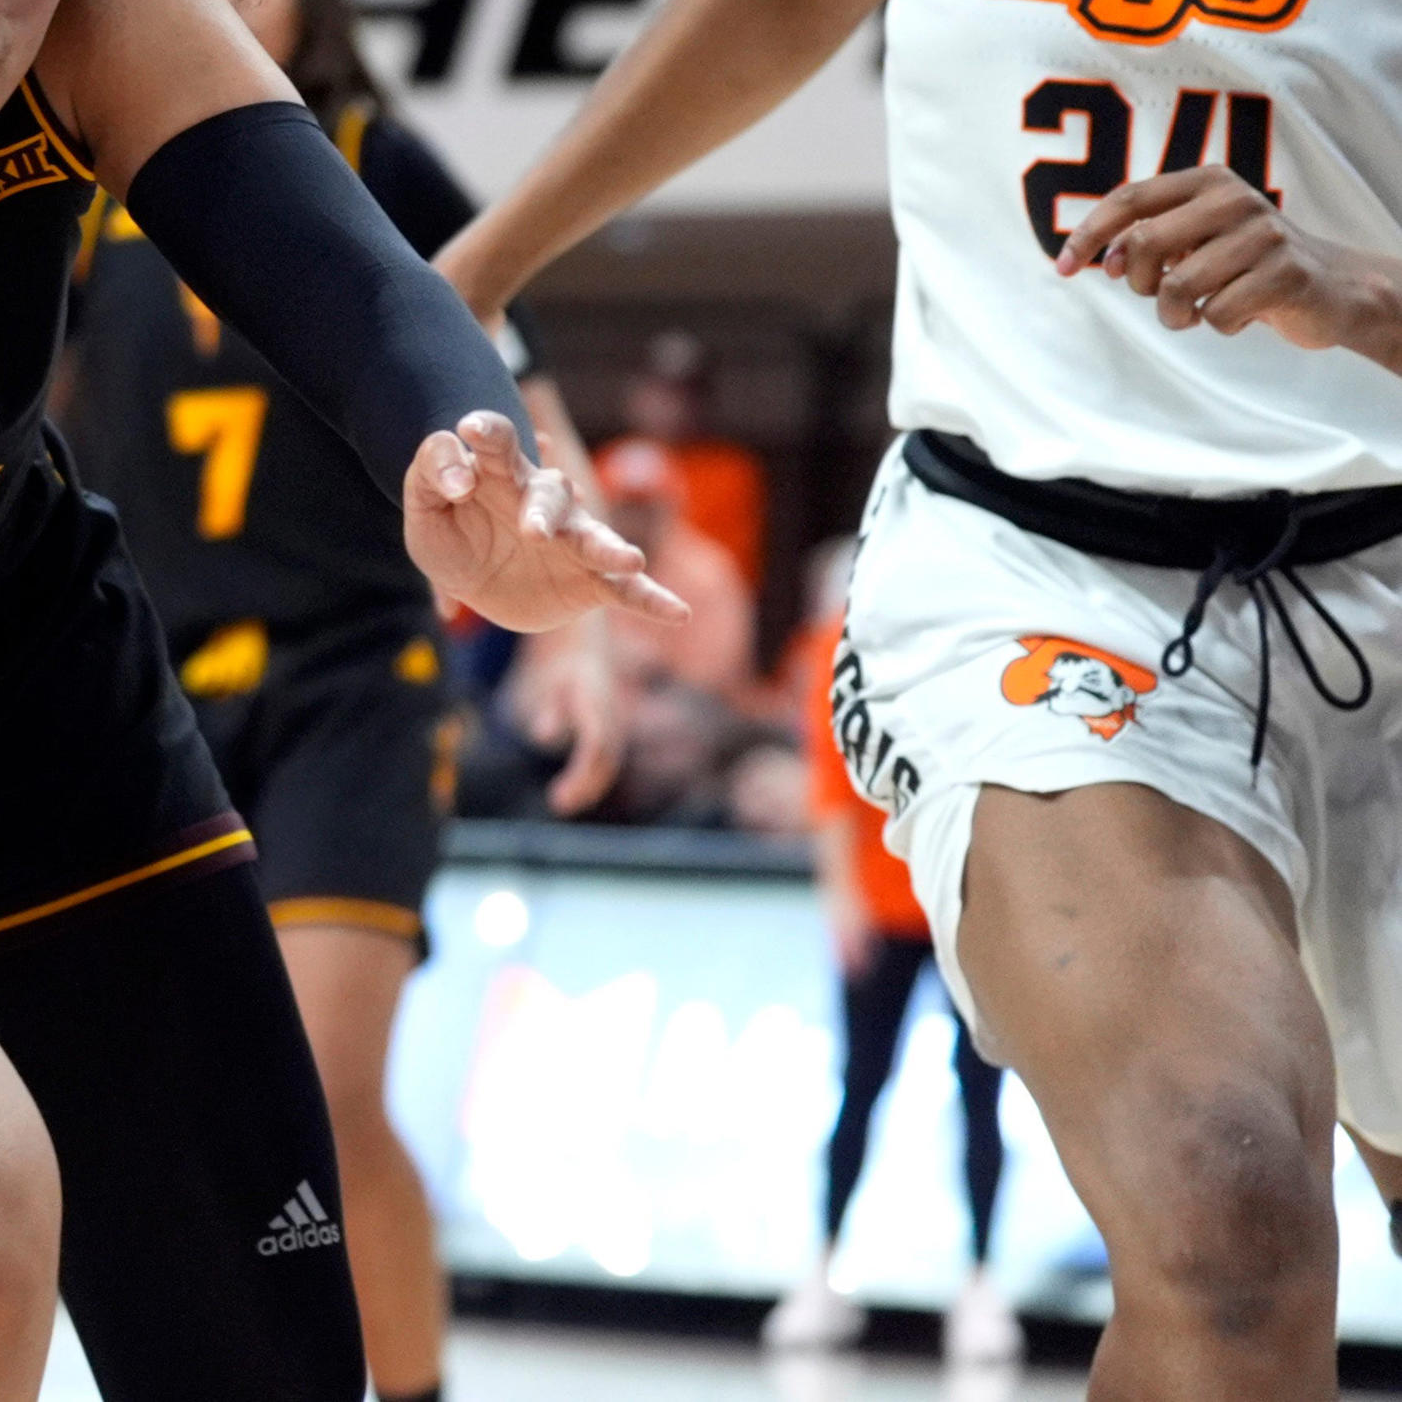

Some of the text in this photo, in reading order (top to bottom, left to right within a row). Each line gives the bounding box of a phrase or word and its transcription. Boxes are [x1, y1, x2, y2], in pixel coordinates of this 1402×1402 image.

[1021, 77, 1284, 268] 24
[167, 384, 267, 541] 7
[256, 1221, 341, 1258] adidas
